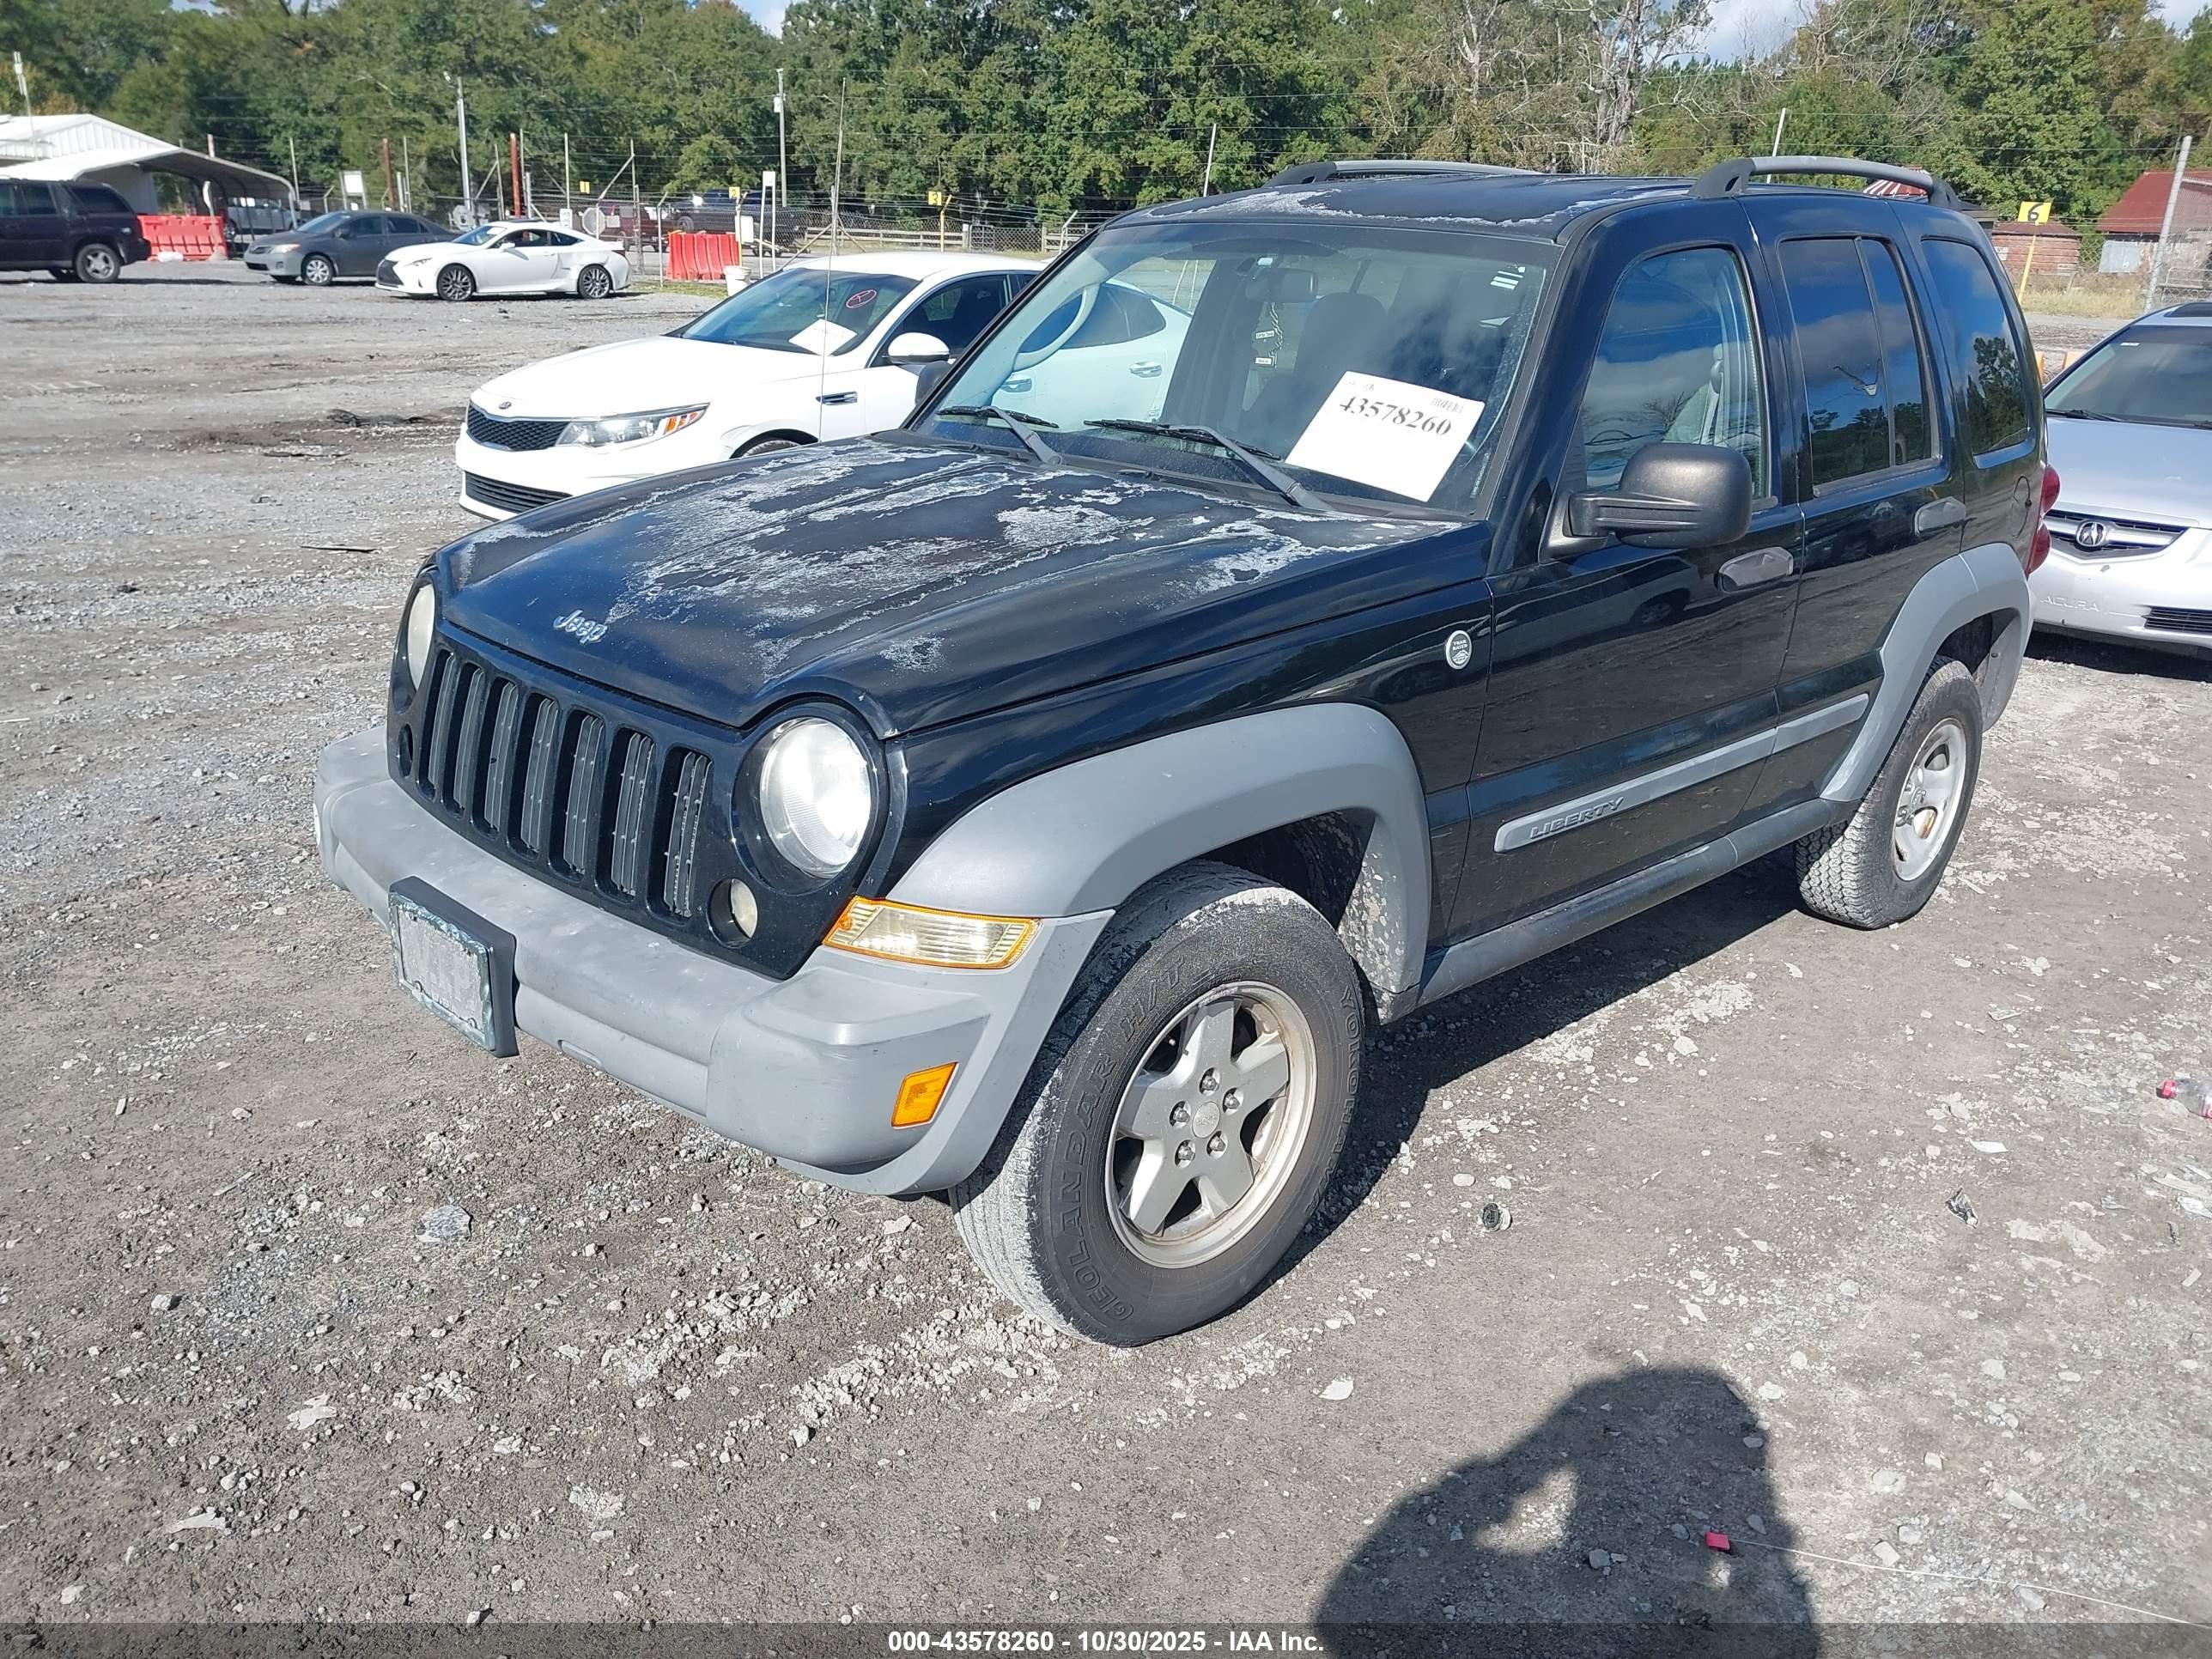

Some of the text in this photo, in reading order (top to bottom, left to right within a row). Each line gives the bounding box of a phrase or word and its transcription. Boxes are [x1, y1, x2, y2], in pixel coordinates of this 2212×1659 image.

[2027, 203, 2044, 222] 6
[1340, 395, 1451, 435] 43578260
[553, 609, 608, 645] Jeep
[1529, 796, 1625, 839] LIBERTY
[1304, 985, 1362, 1217] YOKOHAMA
[1060, 1050, 1134, 1321] GEOLANDAR
